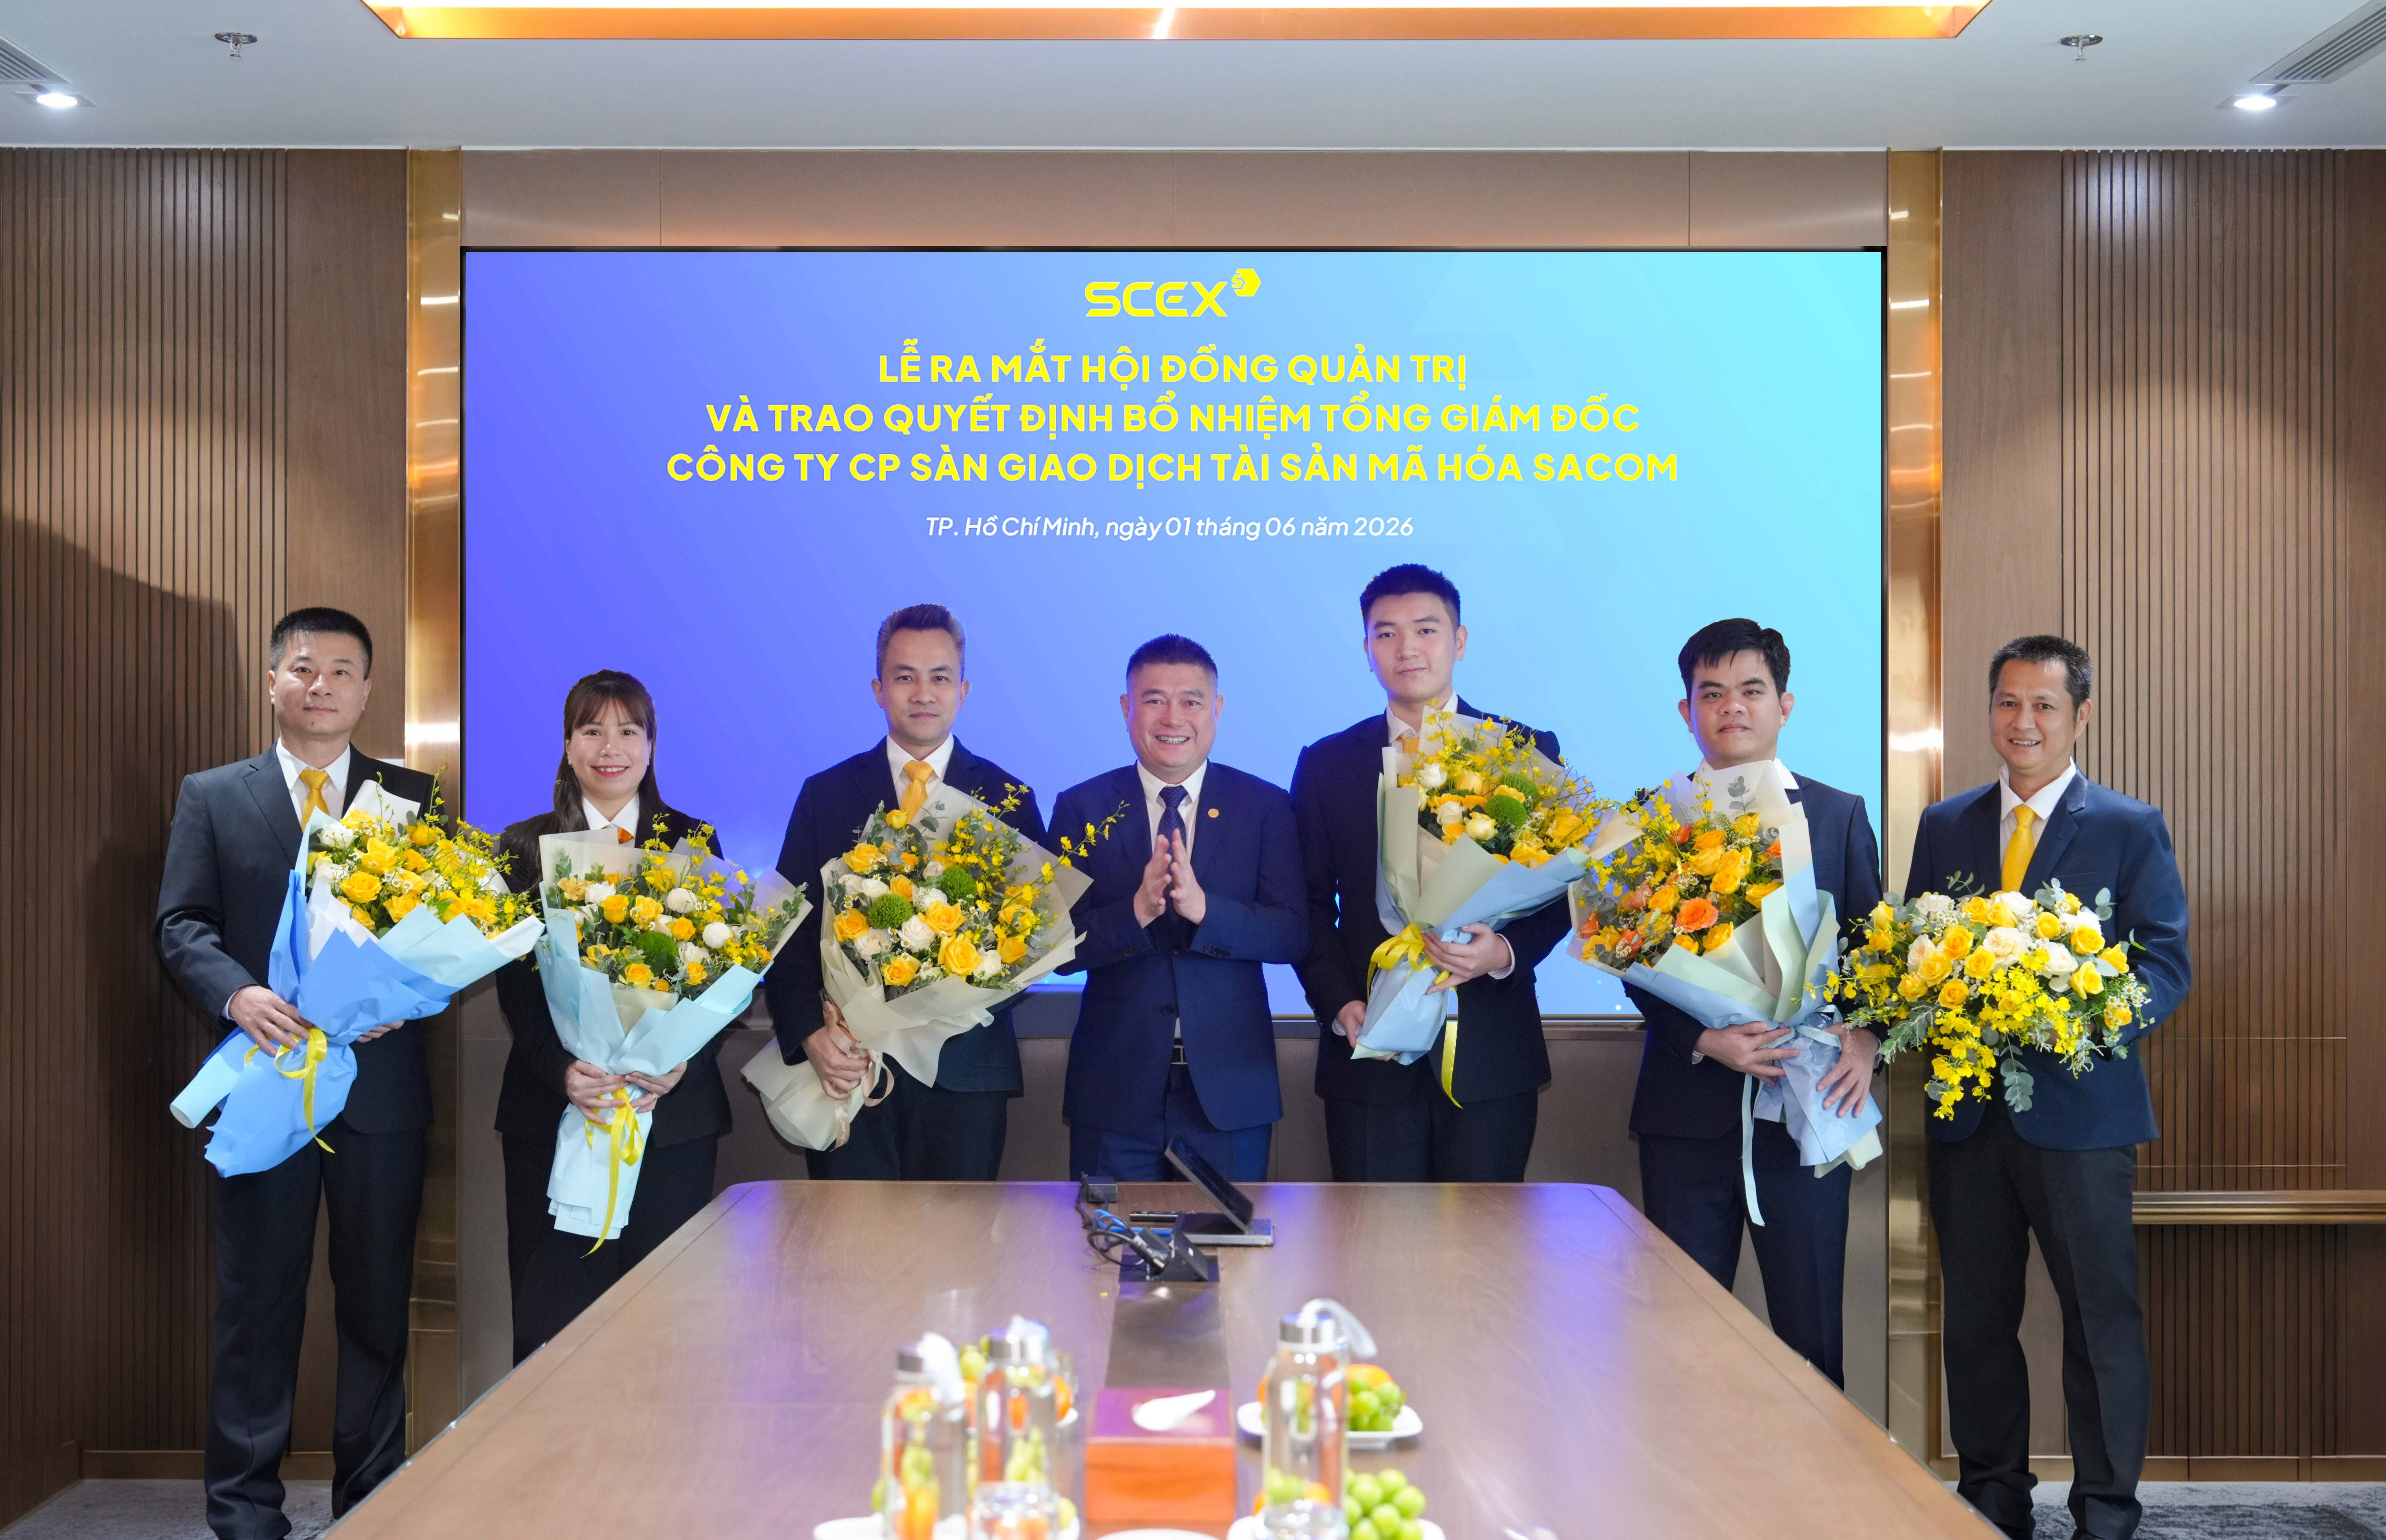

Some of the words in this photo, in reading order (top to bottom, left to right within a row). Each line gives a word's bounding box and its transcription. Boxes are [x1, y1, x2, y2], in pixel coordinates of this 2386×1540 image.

[1085, 281, 1227, 317] SCEX
[880, 339, 920, 382] LỄ
[931, 355, 981, 382] RA
[992, 338, 1071, 382] MẮT
[1082, 346, 1149, 390] HỘI
[1161, 344, 1278, 382] ĐỒNG
[1288, 344, 1400, 385] QUẢN
[1410, 355, 1465, 390] TRỊ
[706, 395, 758, 431] VÀ
[768, 404, 873, 432] TRAO
[884, 393, 1011, 434] QUYẾT
[1020, 404, 1112, 439] ĐỊNH
[1124, 390, 1178, 432] BỔ
[1191, 395, 1310, 439] NHIỆM
[1320, 390, 1431, 432] TỔNG
[1441, 395, 1539, 432] GIÁM
[1551, 393, 1639, 432] ĐỐC
[667, 445, 784, 481] CÔNG
[794, 454, 839, 481] TY
[850, 454, 900, 481] CP
[911, 445, 986, 481] SÀN
[998, 454, 1096, 481] GIAO
[1109, 454, 1200, 489] DỊCH
[1211, 445, 1268, 481] TÀI
[1281, 443, 1356, 481] SẢN
[1369, 445, 1427, 481] MÃ
[1439, 445, 1522, 481] HÓA
[1534, 454, 1676, 481] SACOM
[926, 517, 958, 536] TP.
[965, 515, 998, 536] Hồ
[1002, 516, 1041, 536] Chí
[1043, 517, 1099, 538] Minh,
[1105, 516, 1163, 541] ngày
[1165, 517, 1191, 536] 01
[1196, 516, 1261, 541] tháng
[1265, 517, 1295, 536] 06
[1301, 516, 1348, 536] năm
[1353, 517, 1413, 536] 2026
